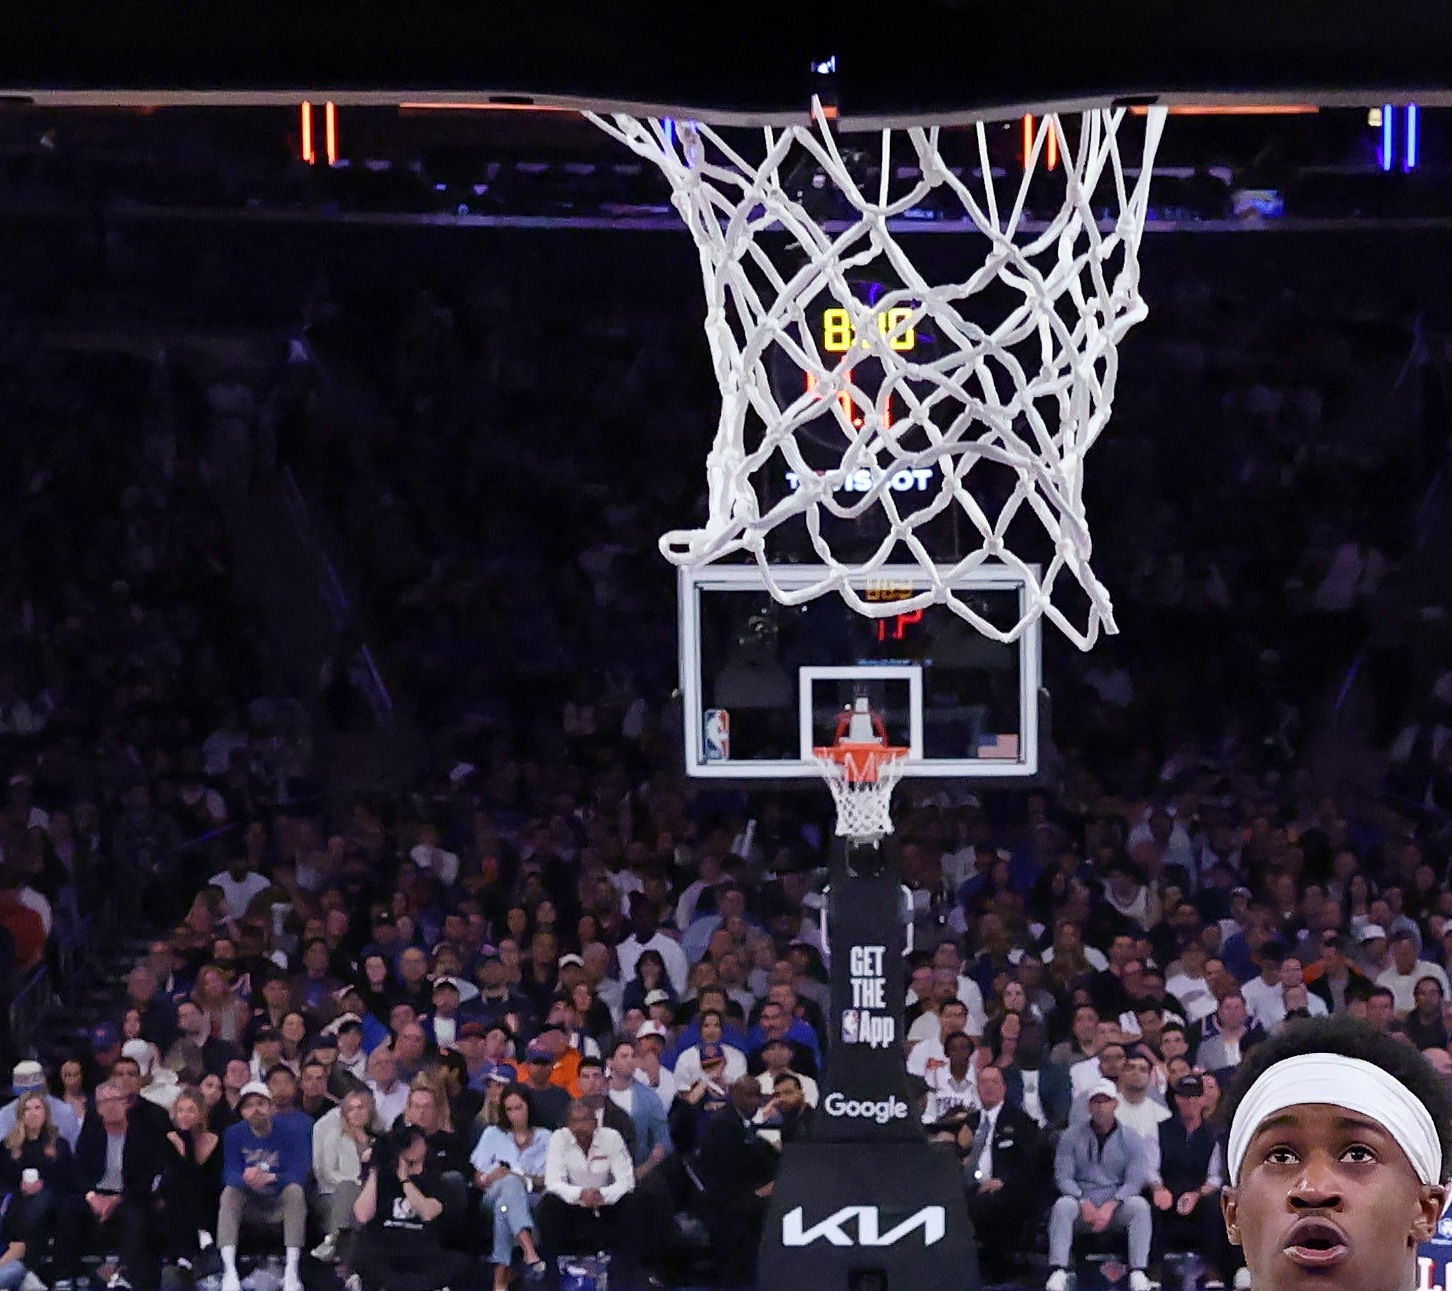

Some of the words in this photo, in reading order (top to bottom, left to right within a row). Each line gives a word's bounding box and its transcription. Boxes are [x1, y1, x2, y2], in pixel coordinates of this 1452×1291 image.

[850, 946, 886, 977] GET
[850, 978, 886, 1009] THE
[859, 1010, 895, 1049] App
[825, 1093, 908, 1124] Google
